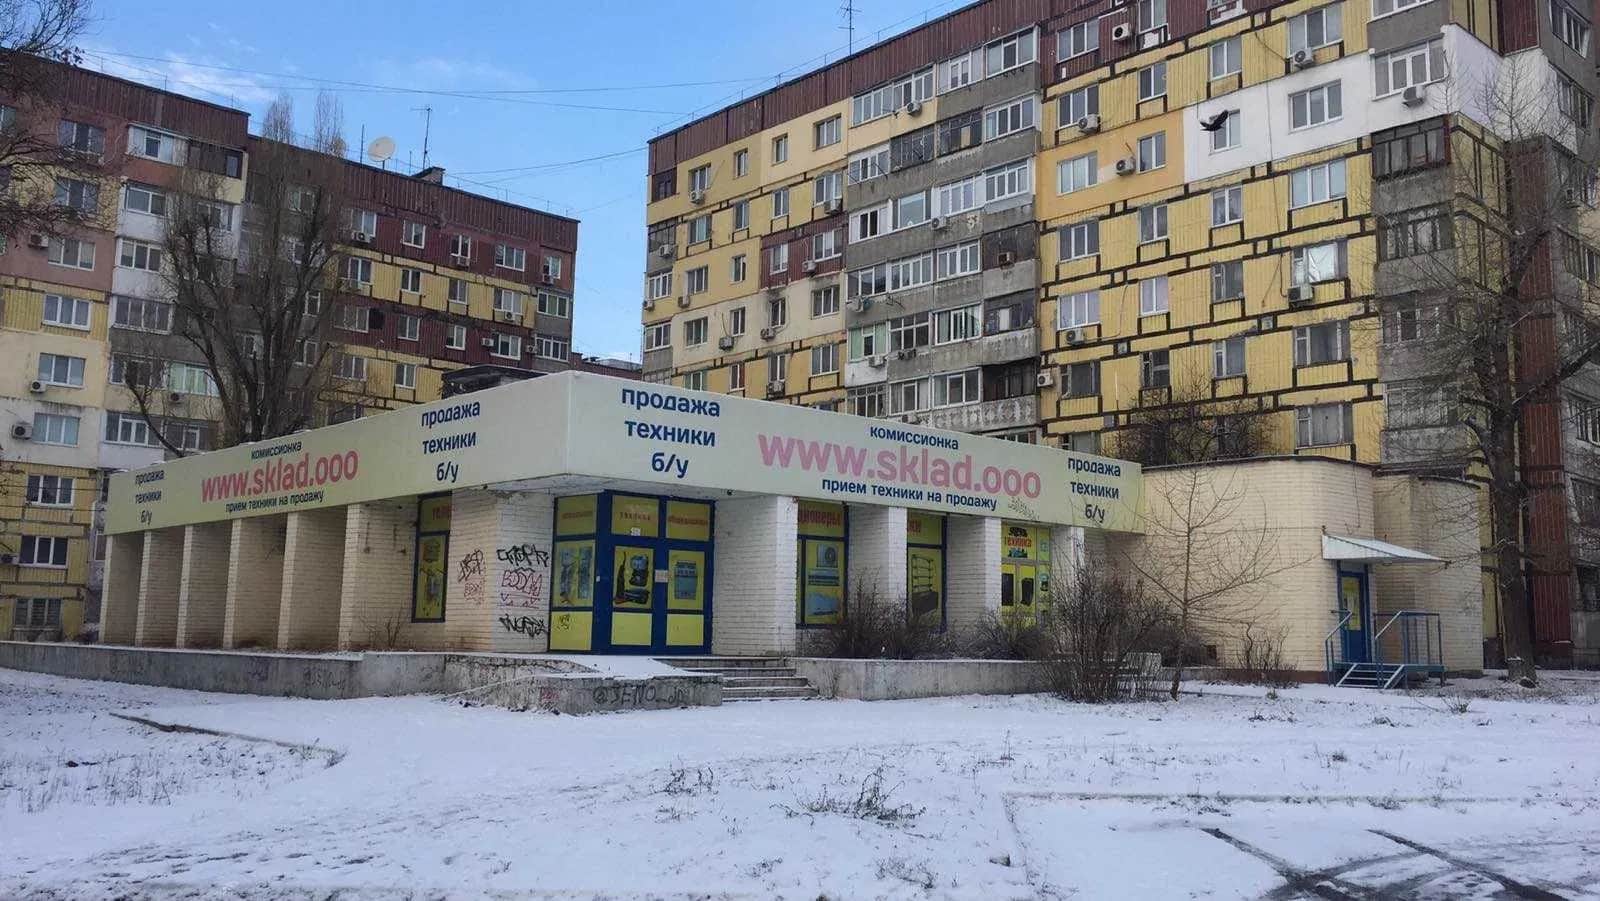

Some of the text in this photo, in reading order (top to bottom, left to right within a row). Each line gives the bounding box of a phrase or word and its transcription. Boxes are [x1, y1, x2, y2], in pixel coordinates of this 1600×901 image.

[620, 388, 721, 418] продажа
[420, 401, 481, 429] продажа
[422, 431, 477, 455] техники
[624, 420, 716, 447] техники
[870, 425, 959, 450] комиссионка
[251, 441, 303, 460] комиссионка
[134, 469, 165, 485] продажа
[201, 450, 360, 502] www.sklad.ooo
[436, 461, 459, 483] б/у
[651, 452, 689, 479] б/у
[758, 434, 1041, 498] www.sklad.ooo
[1067, 457, 1121, 477] продажа
[134, 489, 163, 504] техники
[225, 490, 324, 513] прием техники на продажу
[822, 478, 867, 495] прием
[871, 483, 923, 501] техники
[927, 491, 942, 503] на
[945, 494, 998, 512] продажу
[1070, 481, 1120, 499] техники
[140, 509, 153, 526] б/у
[1085, 503, 1105, 523] б/у
